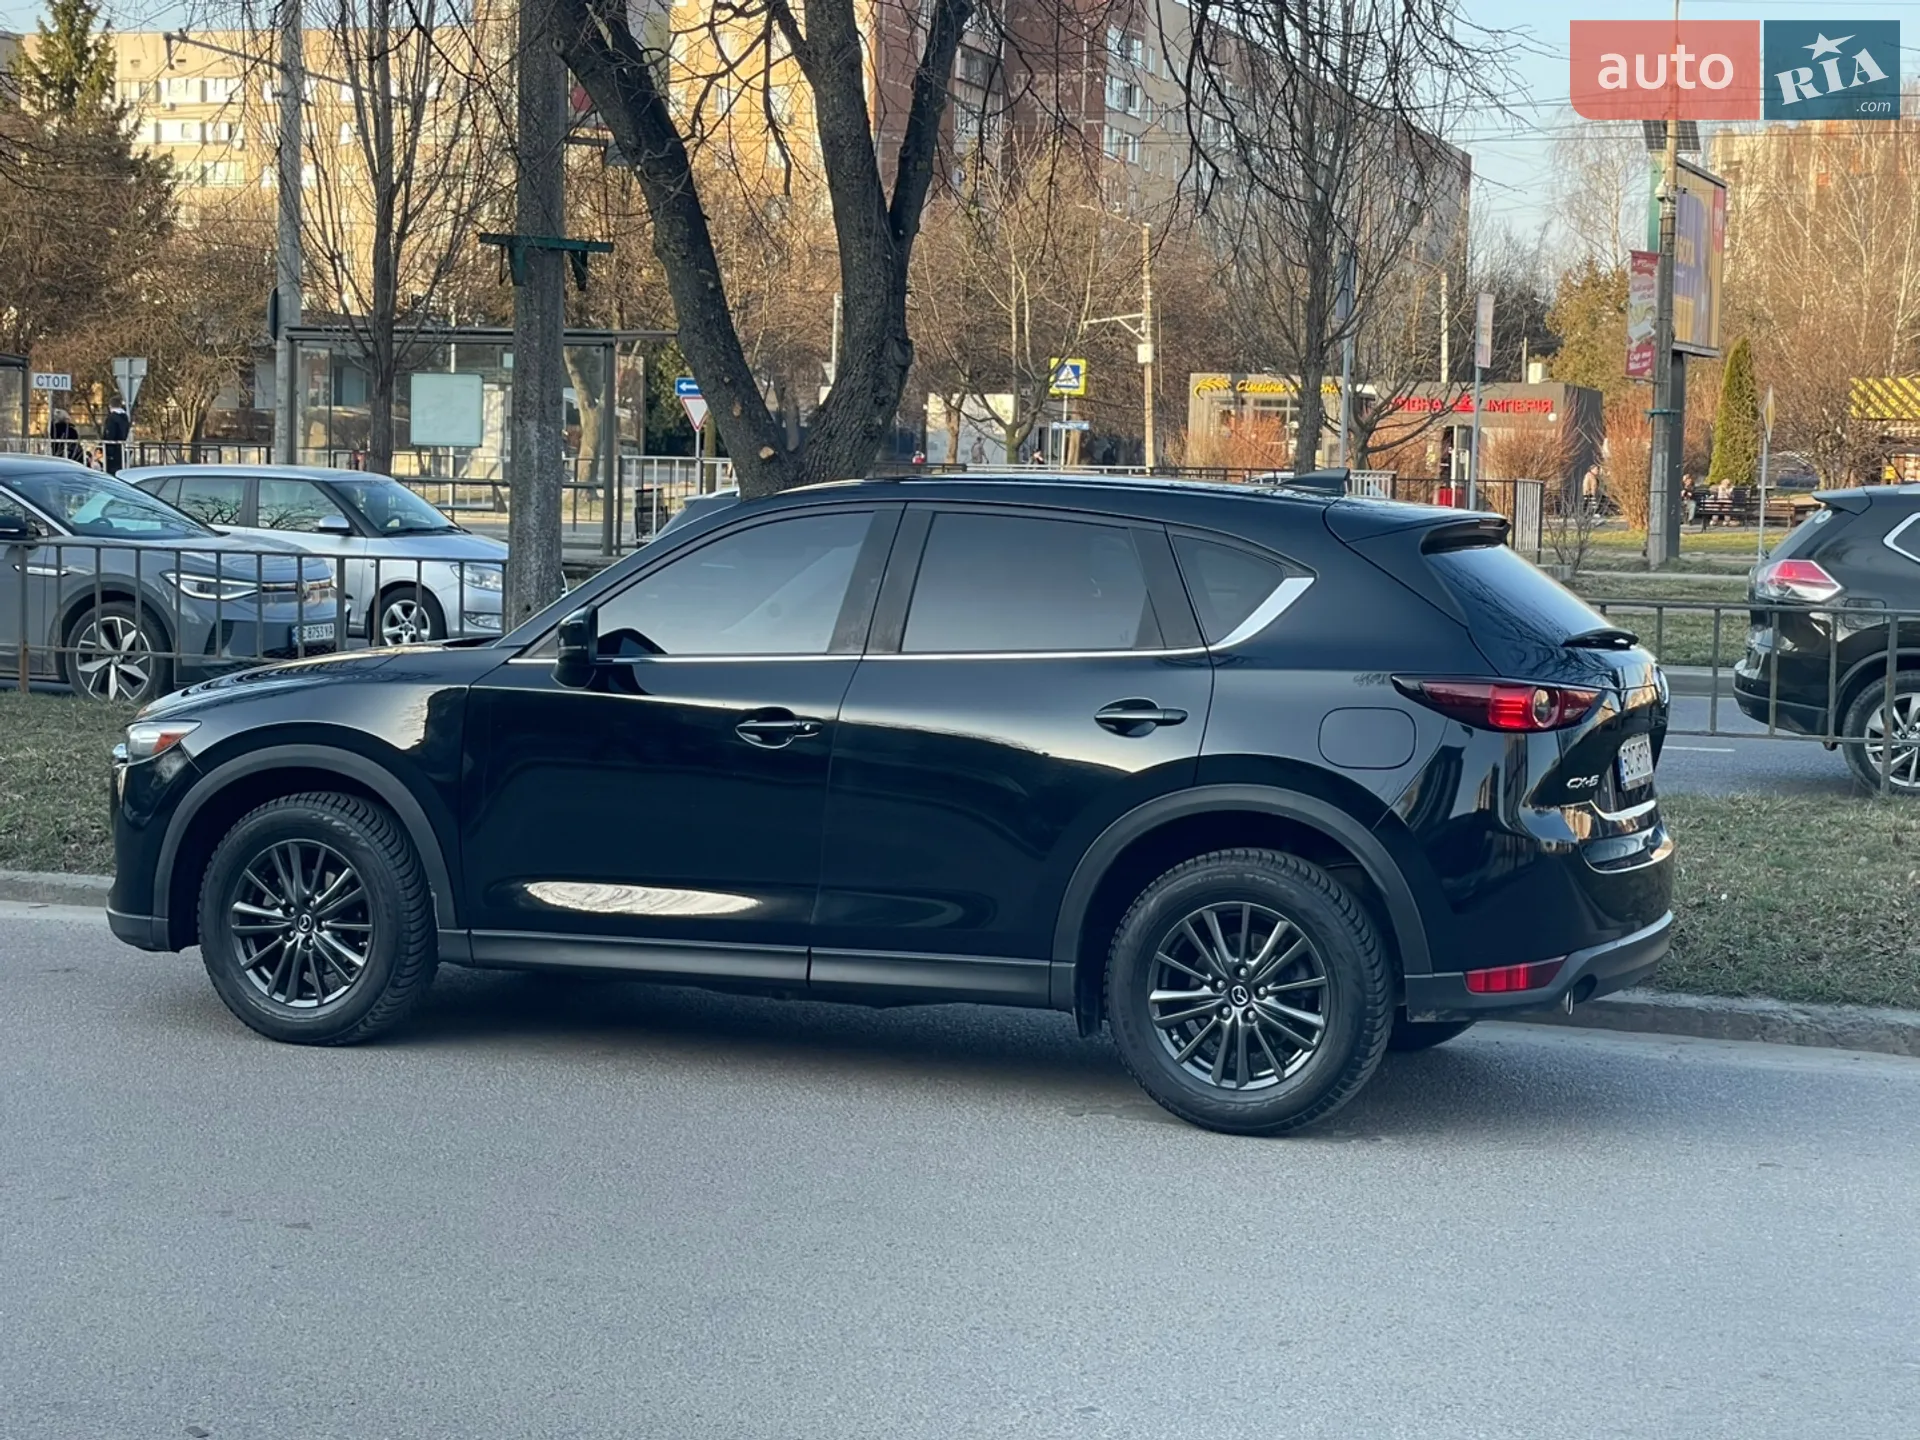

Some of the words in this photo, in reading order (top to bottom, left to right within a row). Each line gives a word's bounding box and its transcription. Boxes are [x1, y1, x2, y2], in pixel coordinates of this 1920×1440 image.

[36, 374, 68, 388] СТОП
[1487, 397, 1554, 414] ІМПЕРІЯ
[1566, 774, 1600, 789] CX-5
